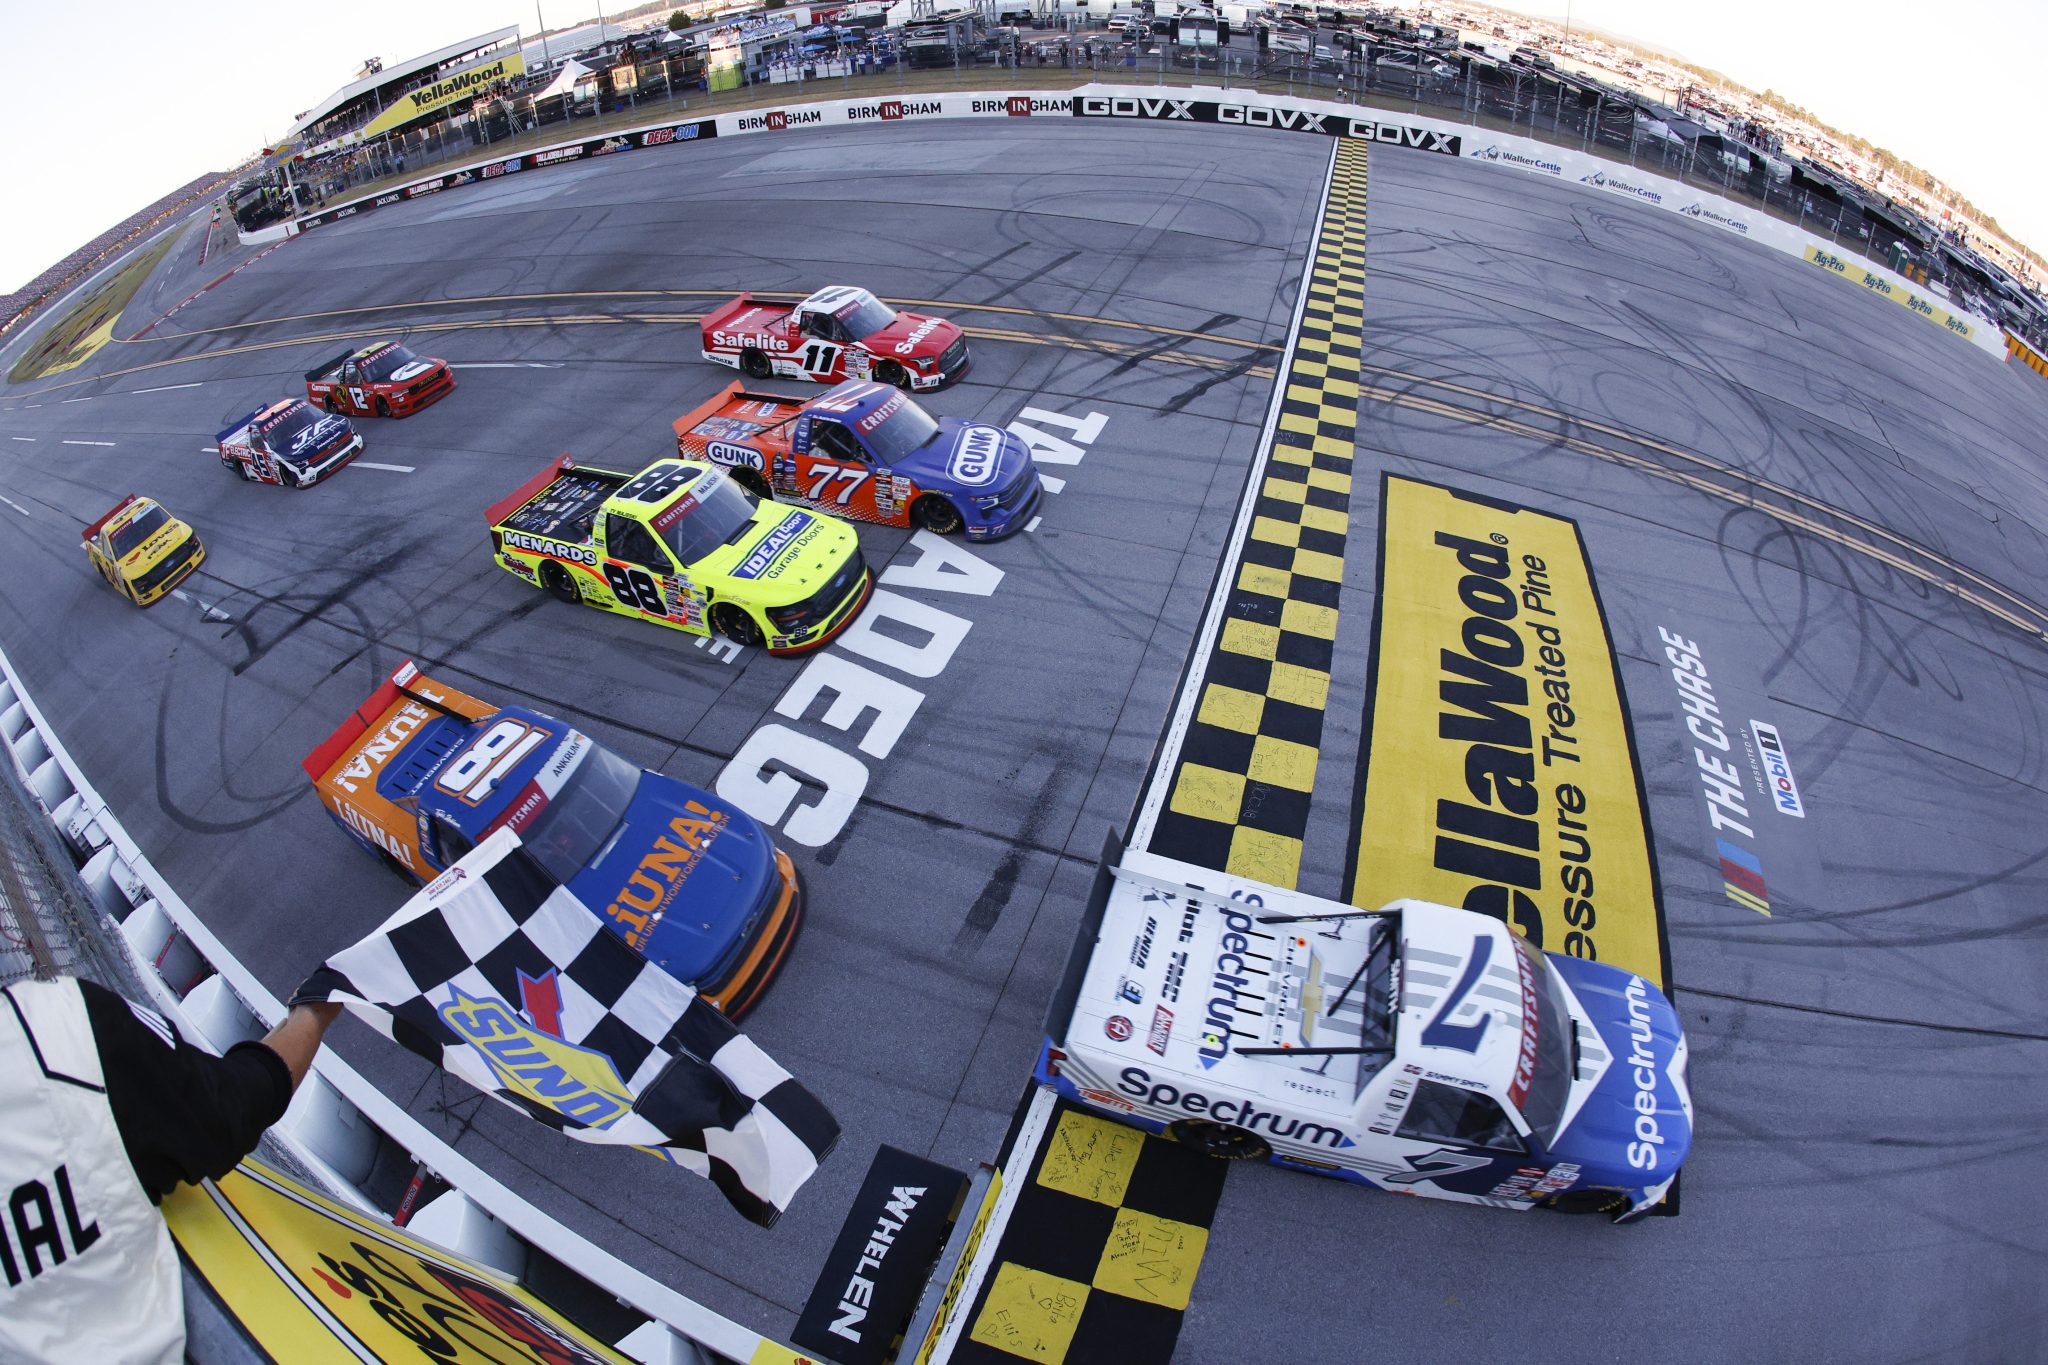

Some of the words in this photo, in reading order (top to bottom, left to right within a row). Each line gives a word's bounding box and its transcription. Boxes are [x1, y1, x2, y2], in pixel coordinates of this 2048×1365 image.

[410, 61, 504, 107] YellaWood
[739, 111, 821, 130] BIRMINGHAM
[848, 102, 941, 119] BIRMINGHAM
[972, 98, 1073, 113] BIRMINGHAM
[1083, 98, 1195, 120] GOVX
[1217, 103, 1327, 133] GOVX
[647, 124, 699, 144] DEGA-CON
[1348, 119, 1454, 154] GOVX
[1502, 151, 1534, 166] Walker
[1535, 159, 1562, 173] Cattle
[1608, 179, 1637, 194] Walker
[1637, 188, 1662, 202] Cattle
[1703, 209, 1727, 225] Walker
[1727, 217, 1749, 232] Cattle
[361, 343, 400, 367] CRAFTSMAN
[712, 331, 789, 351] Safelite
[803, 345, 837, 373] 11
[264, 400, 308, 432] CRAFTSMAN
[349, 387, 368, 410] 12
[252, 452, 271, 477] 45
[712, 445, 758, 467] GUNK
[960, 430, 994, 478] GUNK
[615, 464, 703, 504] 88
[808, 463, 869, 504] 77
[658, 497, 695, 526] CRAFTSMAN
[506, 532, 596, 565] MENARDS
[743, 529, 792, 575] IDEAL
[767, 547, 801, 579] Garage
[797, 524, 824, 547] Doors
[602, 562, 669, 617] 88
[1522, 554, 1557, 616] Pine
[1534, 622, 1581, 767] Treated
[1658, 626, 1731, 752] CHASE
[1434, 530, 1543, 949] ellaWood
[1740, 728, 1749, 739] BY
[409, 737, 465, 796] CHEVROLET
[437, 721, 546, 802] 18
[552, 742, 581, 777] ANKRUM
[1744, 742, 1766, 795] PRESENTED
[1695, 747, 1755, 838] THE
[1765, 752, 1798, 811] Mobil
[507, 792, 542, 830] FTSMAN
[333, 795, 415, 870] LiUNA!
[663, 853, 705, 906] WORKFORCE
[1556, 783, 1597, 960] essure
[1162, 951, 1188, 1003] TMC
[1420, 934, 1494, 1056] 7
[1513, 936, 1540, 1091] CRAFTSMAN
[1425, 1071, 1460, 1085] SAMMY
[1460, 1079, 1489, 1090] SMITH
[1625, 983, 1665, 1171] Spectrum
[1117, 1067, 1344, 1148] Spectrum
[1382, 1149, 1494, 1184] 7
[828, 1187, 928, 1344] WHELEN
